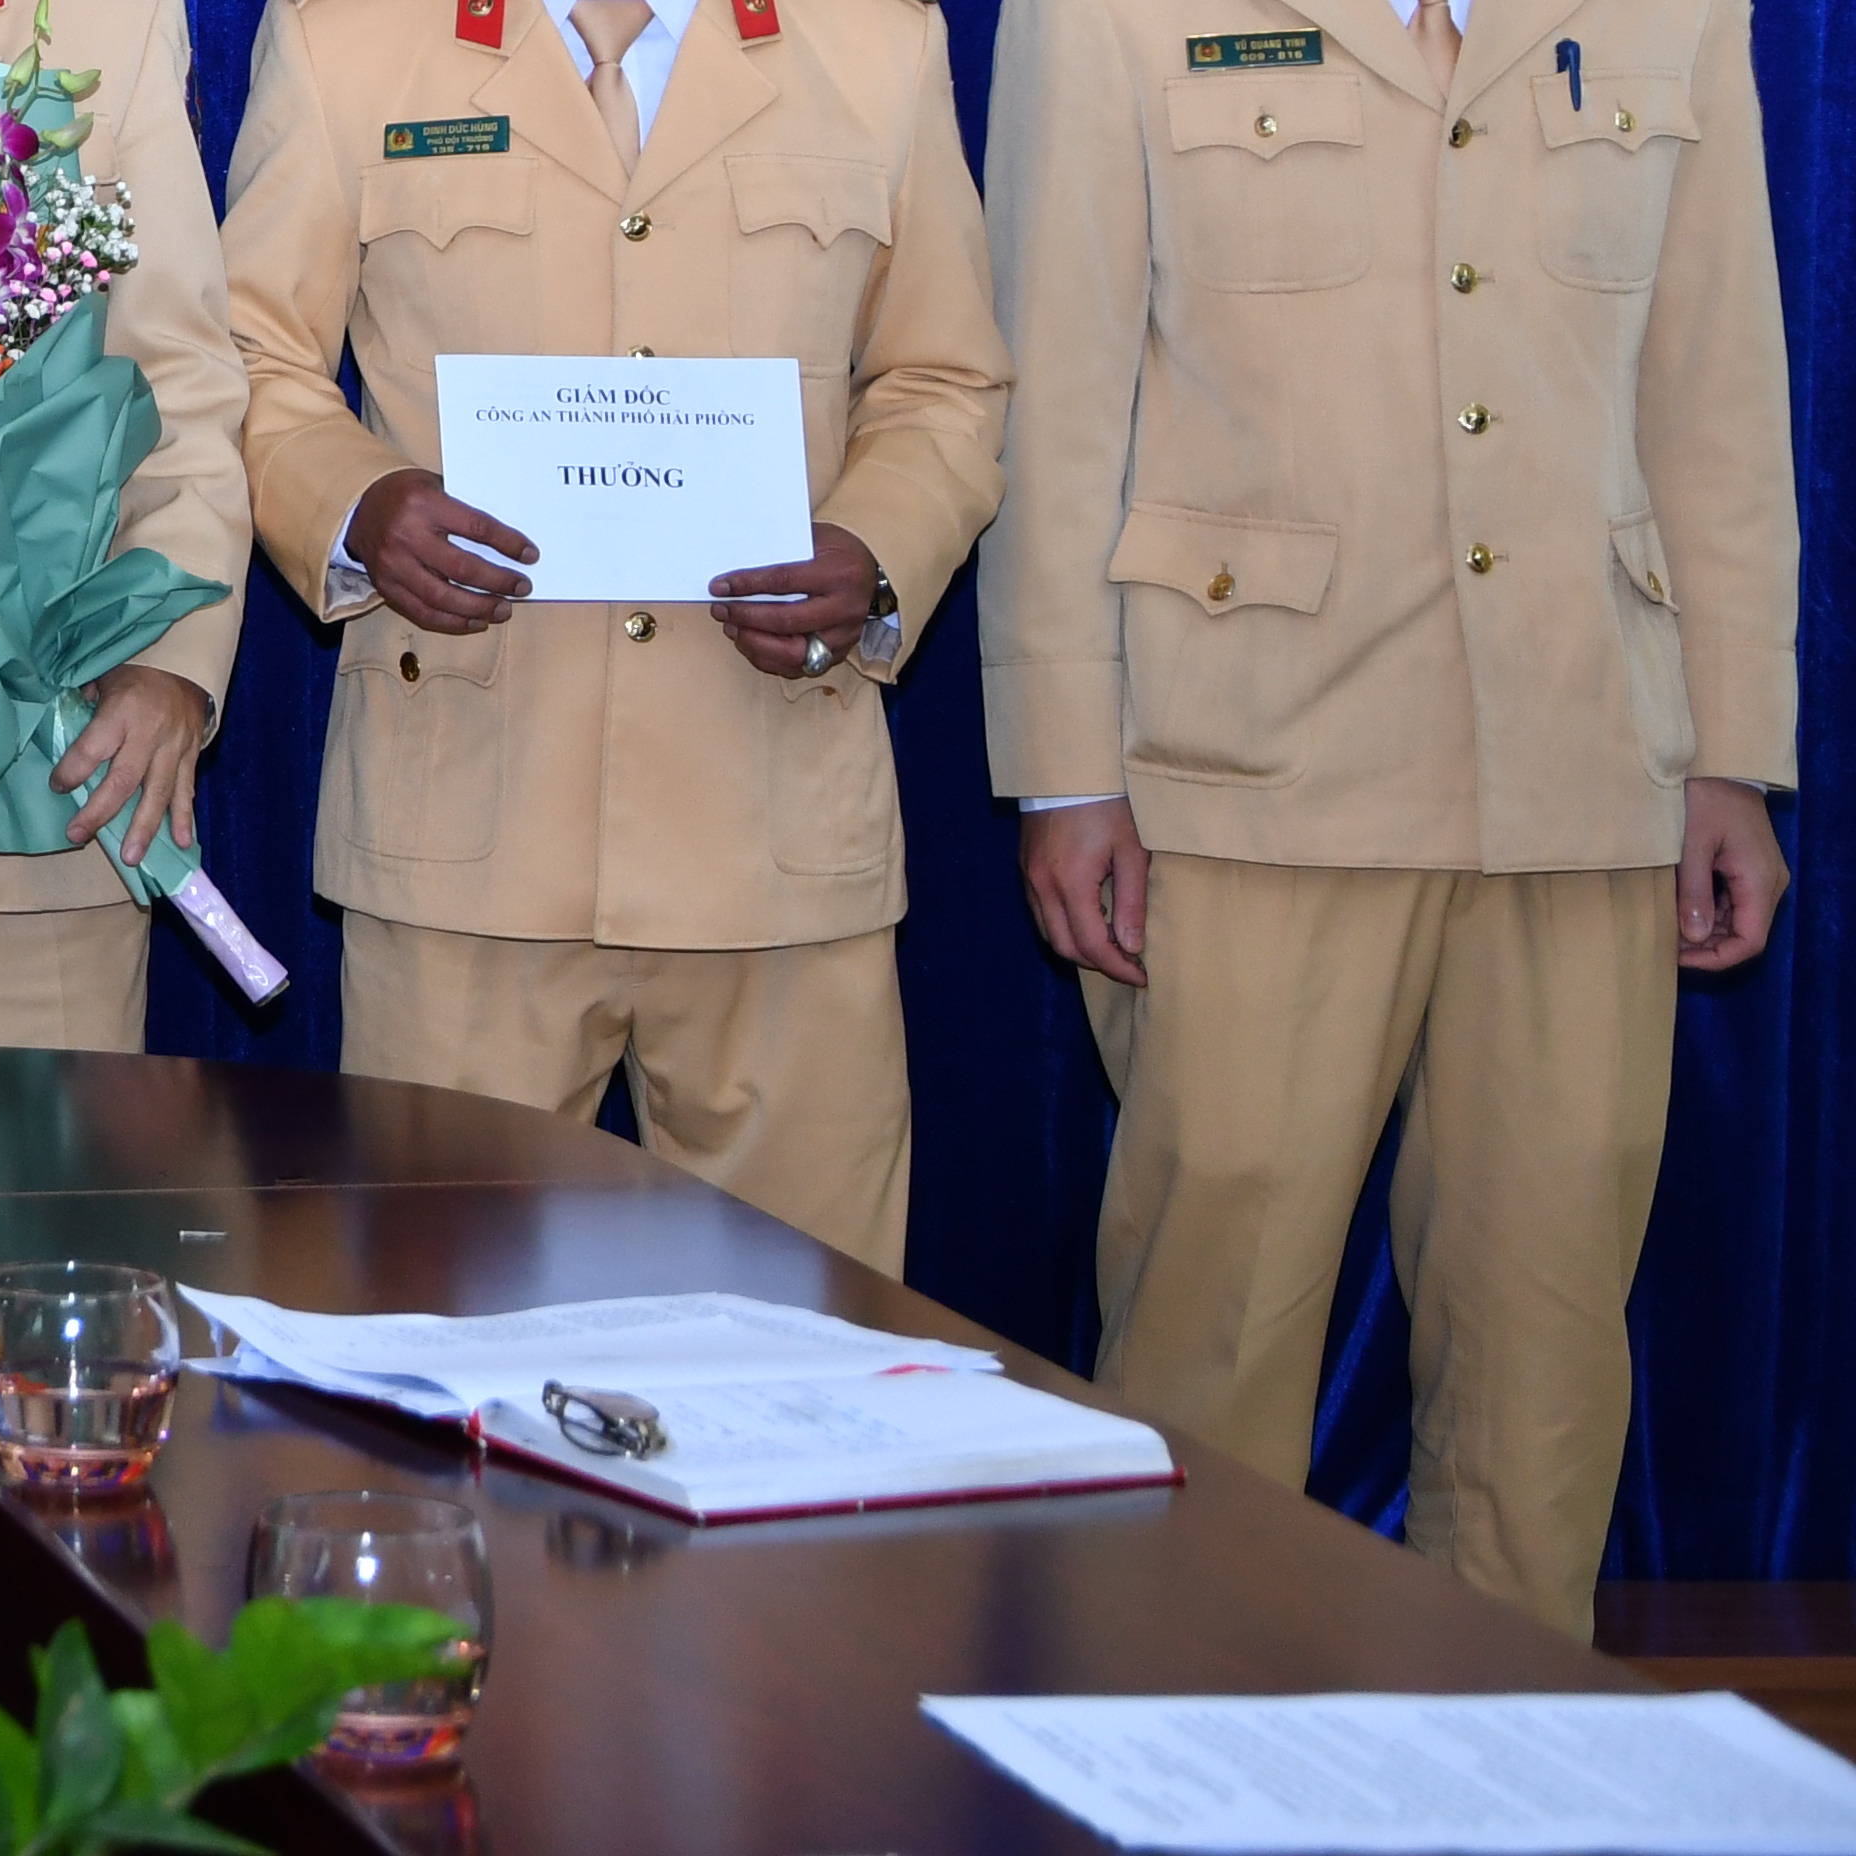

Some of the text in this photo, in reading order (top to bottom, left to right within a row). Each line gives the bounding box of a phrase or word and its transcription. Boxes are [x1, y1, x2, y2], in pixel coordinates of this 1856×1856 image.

[1250, 38, 1282, 50] QUANG
[556, 383, 671, 406] GIÁM ĐỐC
[476, 406, 755, 426] CÔNG AN THÀNH PHỐ HẢI PHÒNG
[557, 460, 684, 489] THƯỞNG
